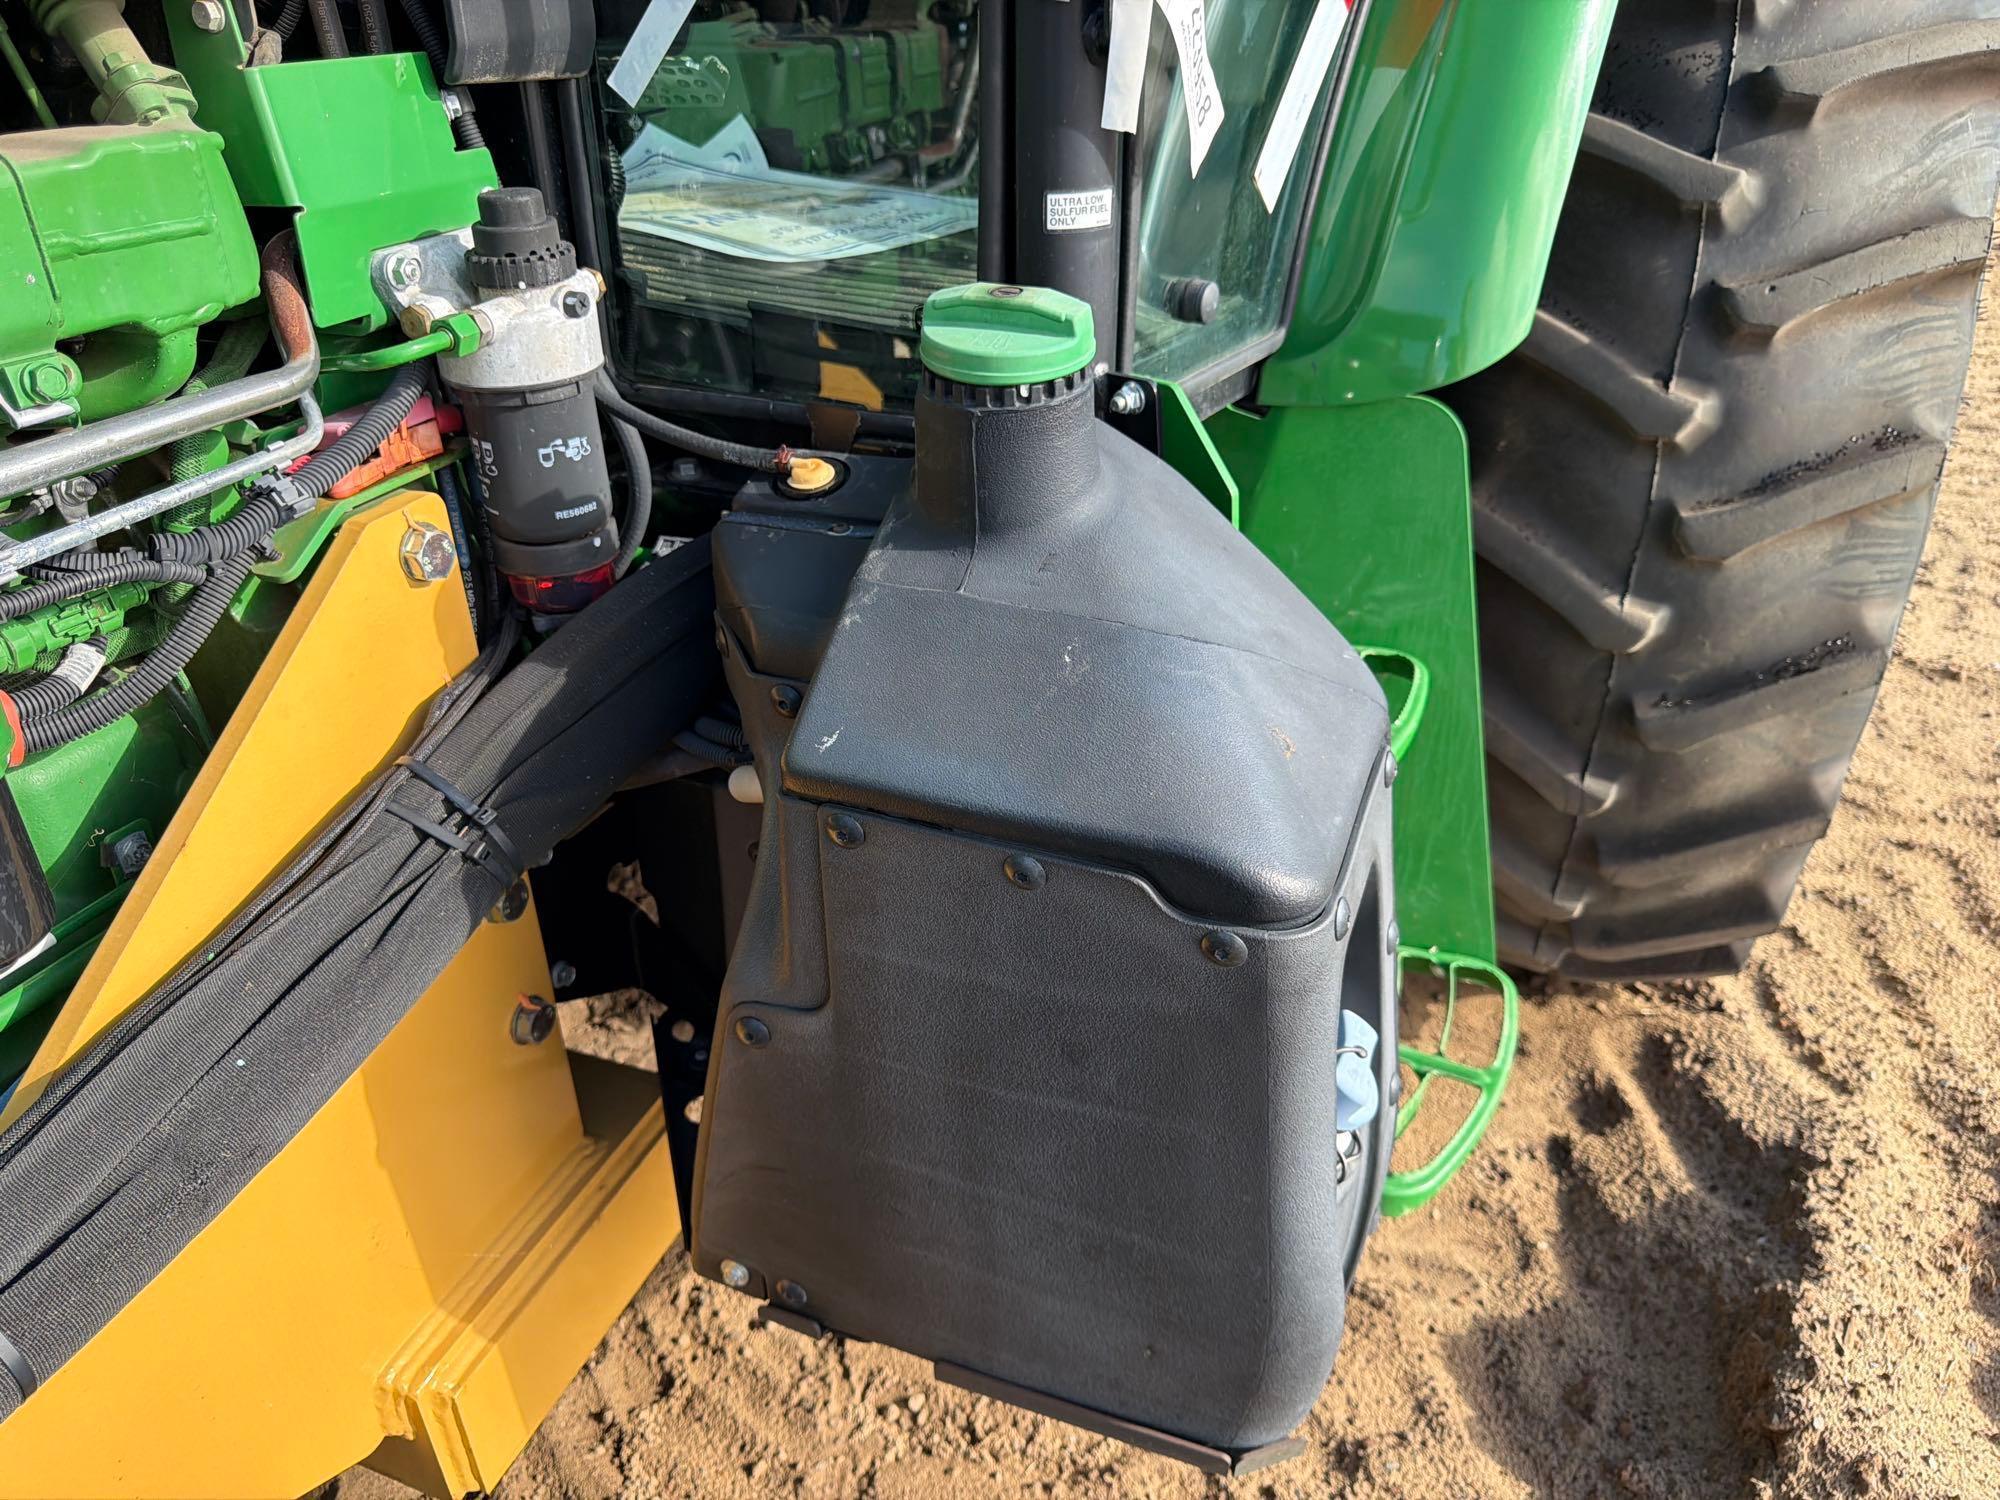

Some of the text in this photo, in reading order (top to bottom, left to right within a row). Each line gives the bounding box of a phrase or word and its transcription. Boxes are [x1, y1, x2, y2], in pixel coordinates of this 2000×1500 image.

[317, 1, 330, 31] Flame
[1050, 195, 1104, 207] ULTRA LOW
[1050, 204, 1108, 217] SULFUR FUEL
[1050, 217, 1076, 226] ONLY
[554, 501, 597, 520] RE560682
